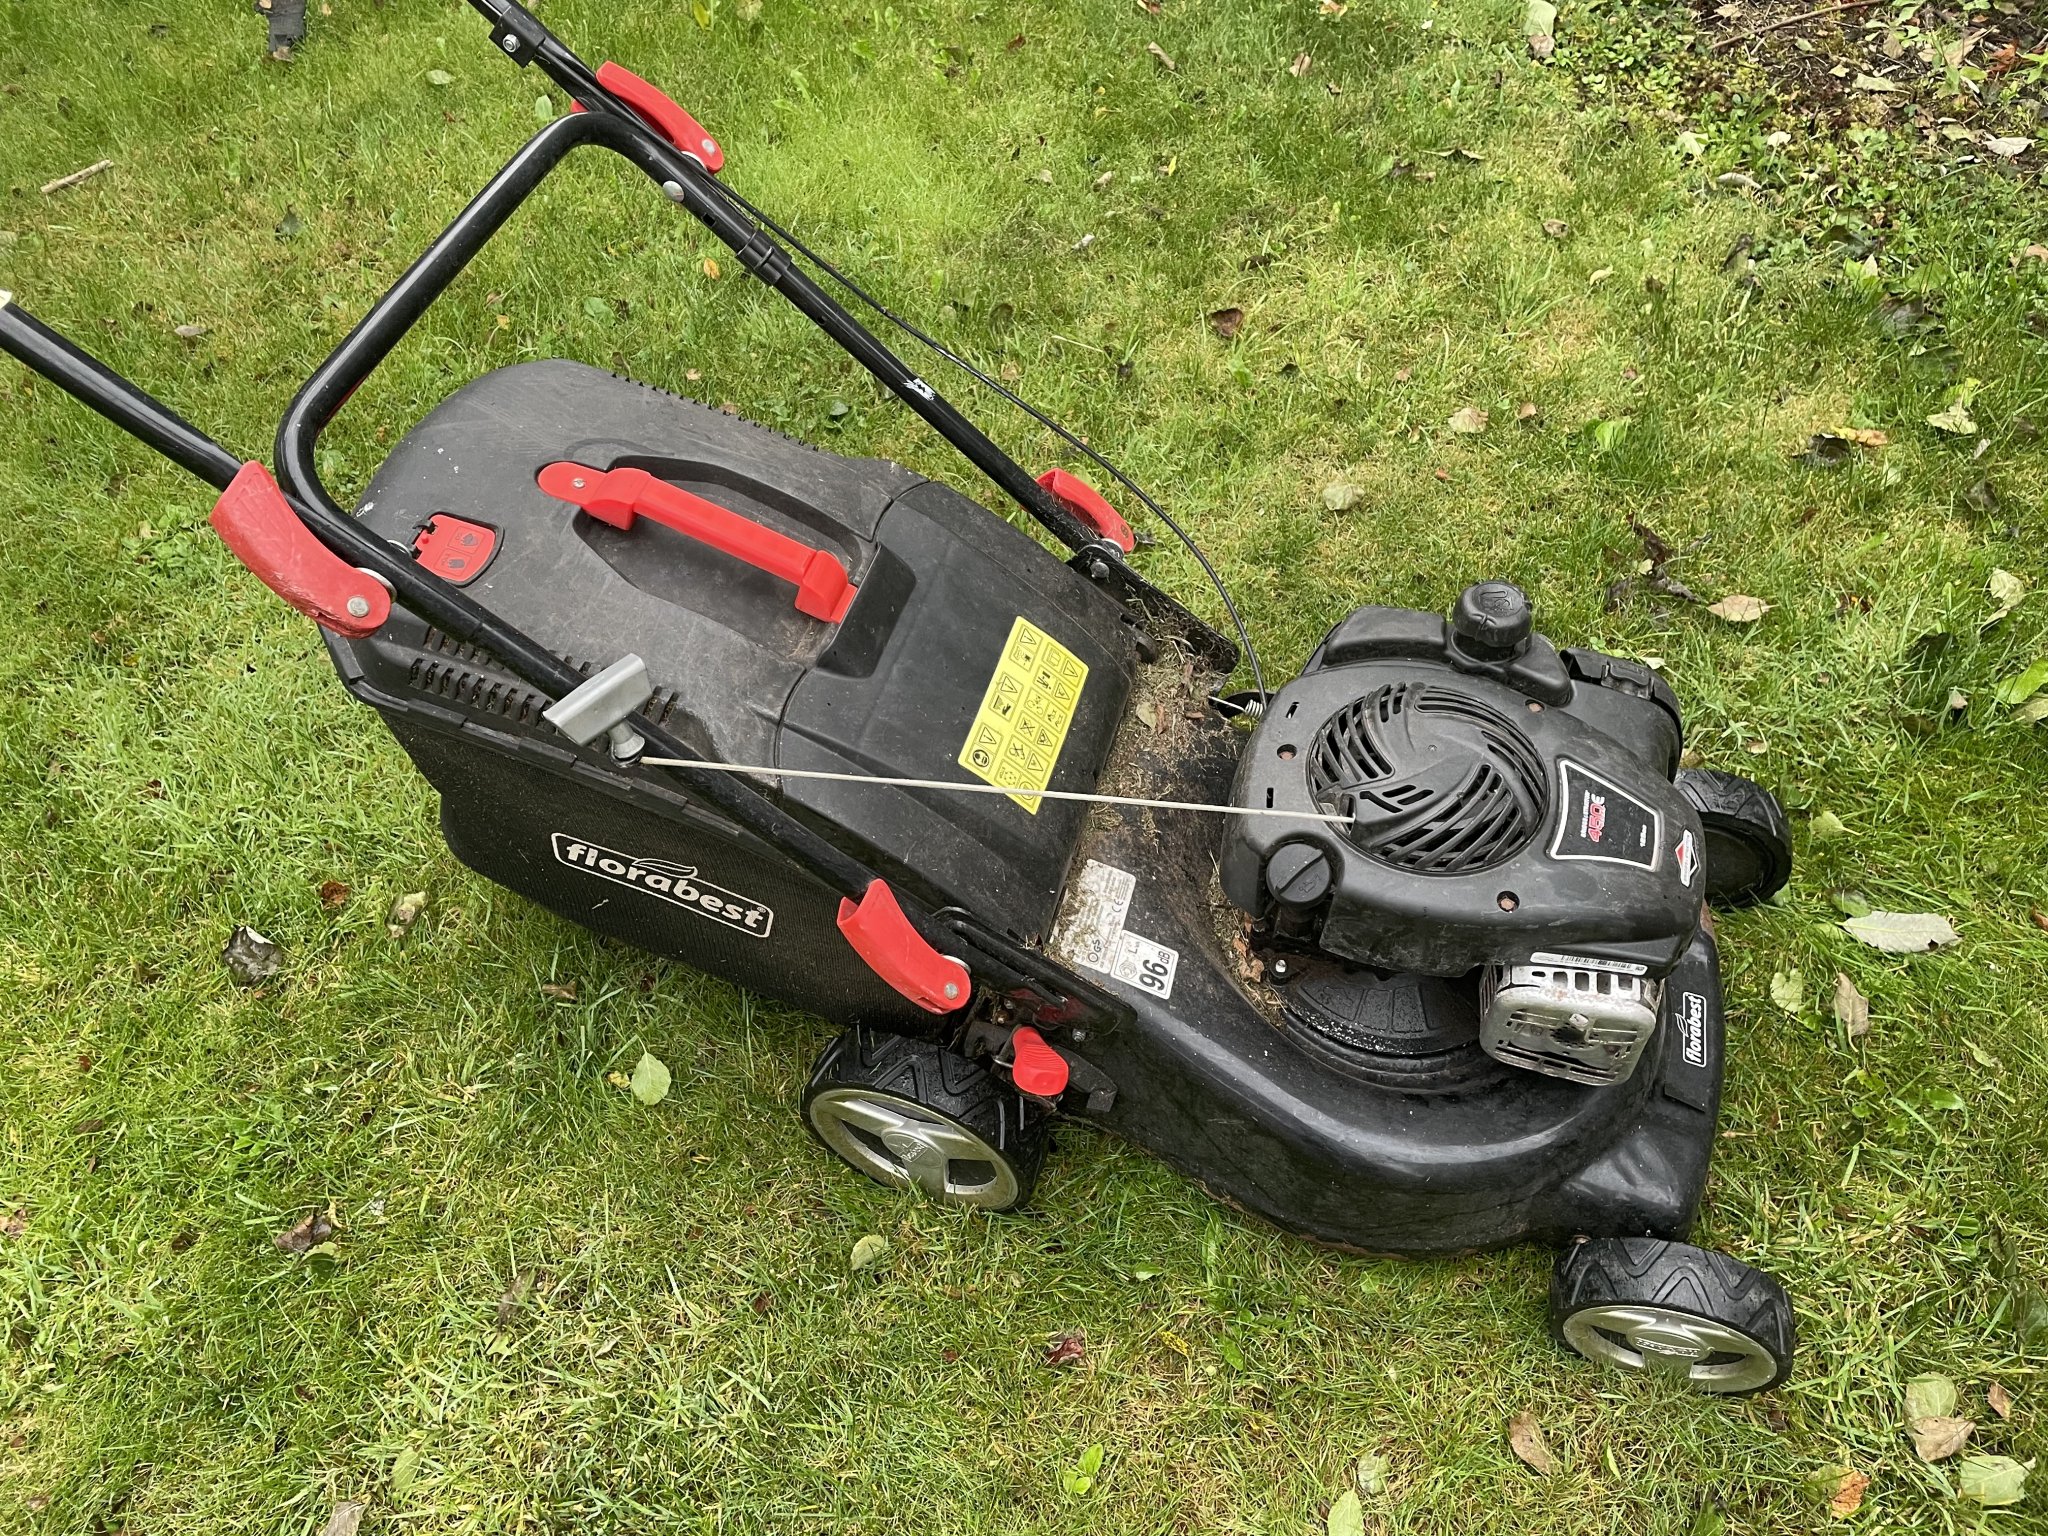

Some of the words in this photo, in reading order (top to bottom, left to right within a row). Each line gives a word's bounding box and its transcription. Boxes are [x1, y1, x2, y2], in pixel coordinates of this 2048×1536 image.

[566, 843, 764, 928] florabest
[1139, 959, 1169, 990] 96
[1158, 950, 1170, 965] dB
[1686, 995, 1702, 1063] florabest
